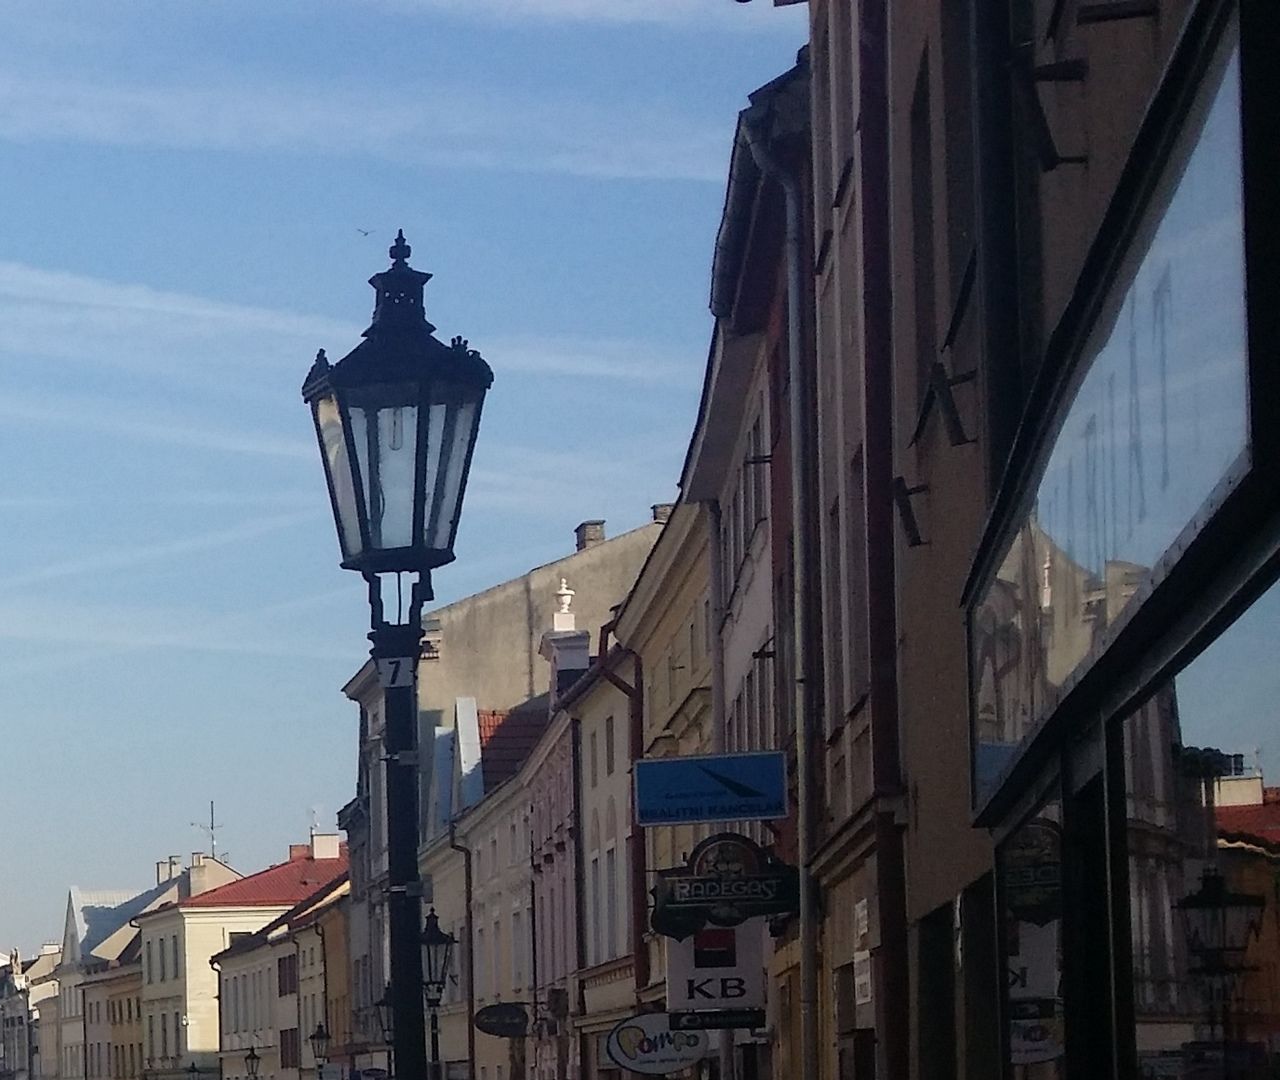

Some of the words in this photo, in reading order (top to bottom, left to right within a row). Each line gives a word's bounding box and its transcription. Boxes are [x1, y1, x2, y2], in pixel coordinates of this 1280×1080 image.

[388, 660, 401, 685] 7
[674, 880, 782, 901] RADEGAST
[687, 977, 746, 1000] KB
